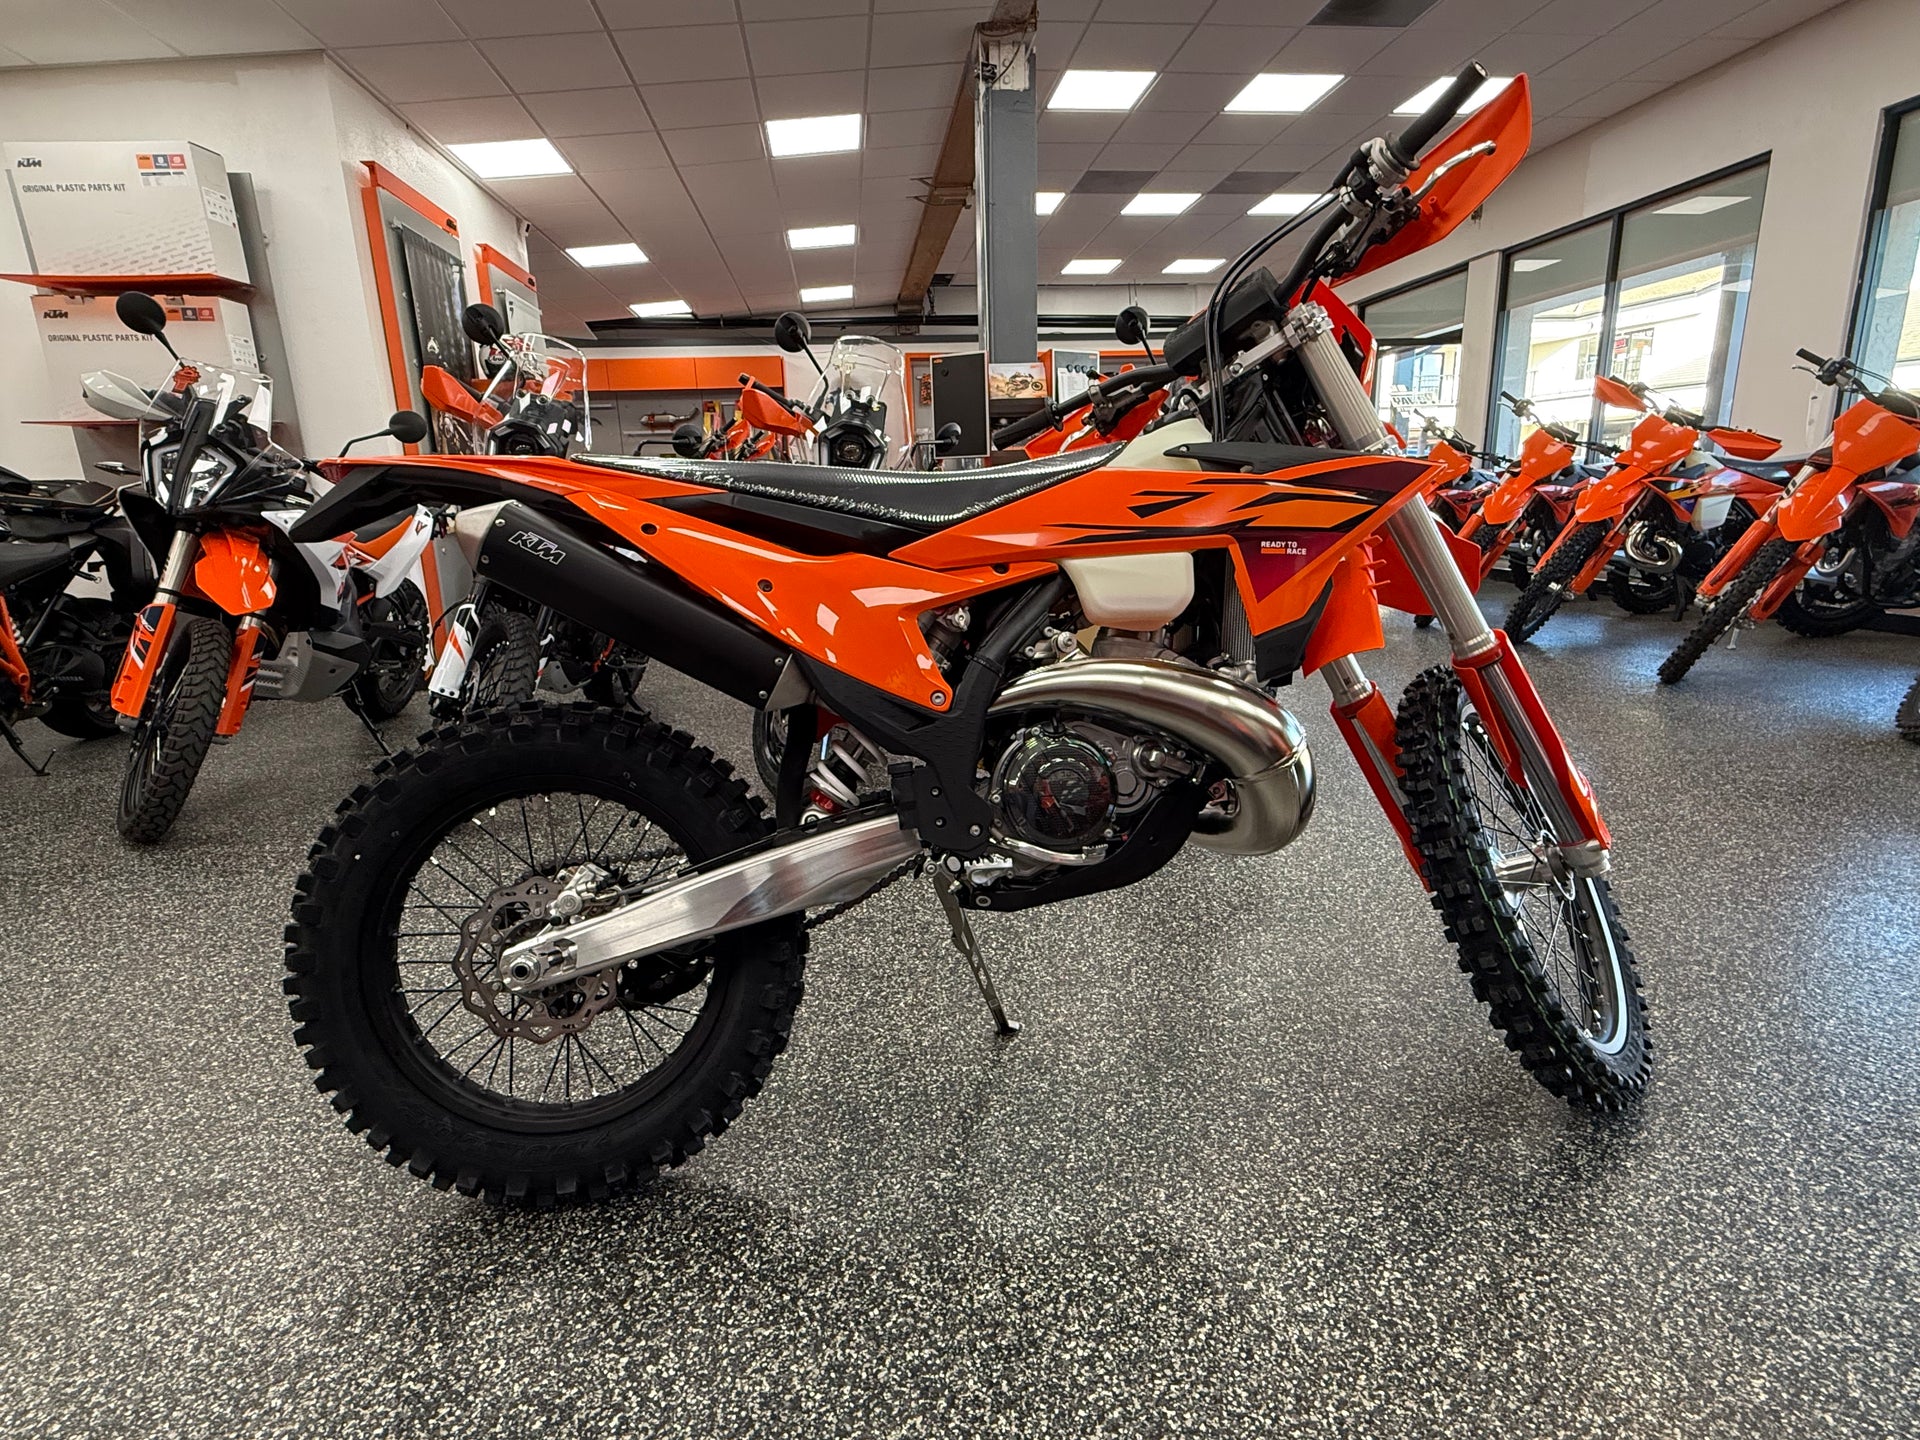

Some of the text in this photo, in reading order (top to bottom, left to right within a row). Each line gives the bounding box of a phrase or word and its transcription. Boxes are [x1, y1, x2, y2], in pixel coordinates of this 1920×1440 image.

[17, 157, 42, 168] KTM
[22, 183, 126, 193] ORIGINAL PLASTIC PARTS KIT
[43, 309, 69, 319] KTM
[47, 334, 81, 342] ORIGINAL
[82, 334, 113, 342] PLASTIC
[115, 334, 140, 342] PARTS
[508, 530, 567, 565] KTM
